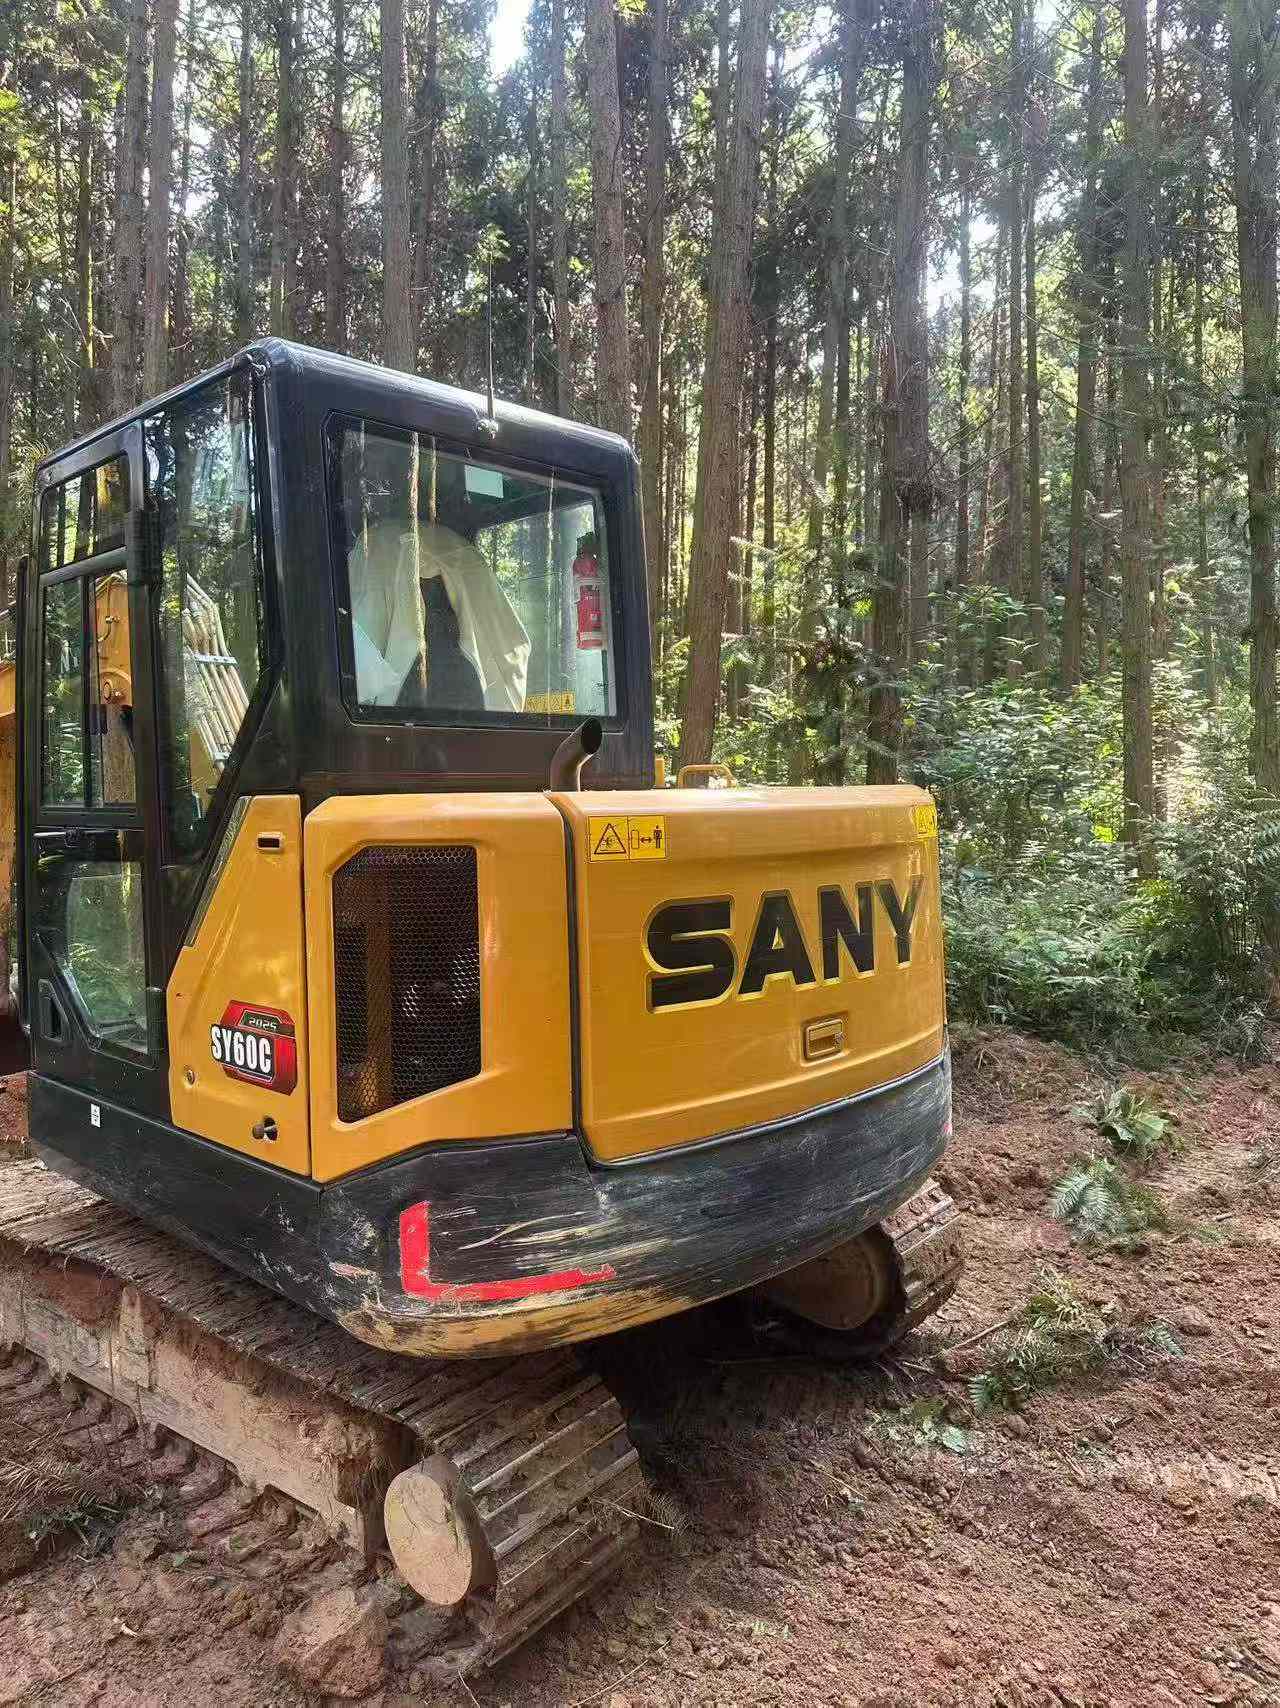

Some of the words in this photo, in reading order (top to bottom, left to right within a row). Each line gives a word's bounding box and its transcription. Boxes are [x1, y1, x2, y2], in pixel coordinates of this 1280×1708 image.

[642, 878, 923, 1012] SANY
[248, 1016, 277, 1030] 2025
[211, 1026, 272, 1073] SY60C
